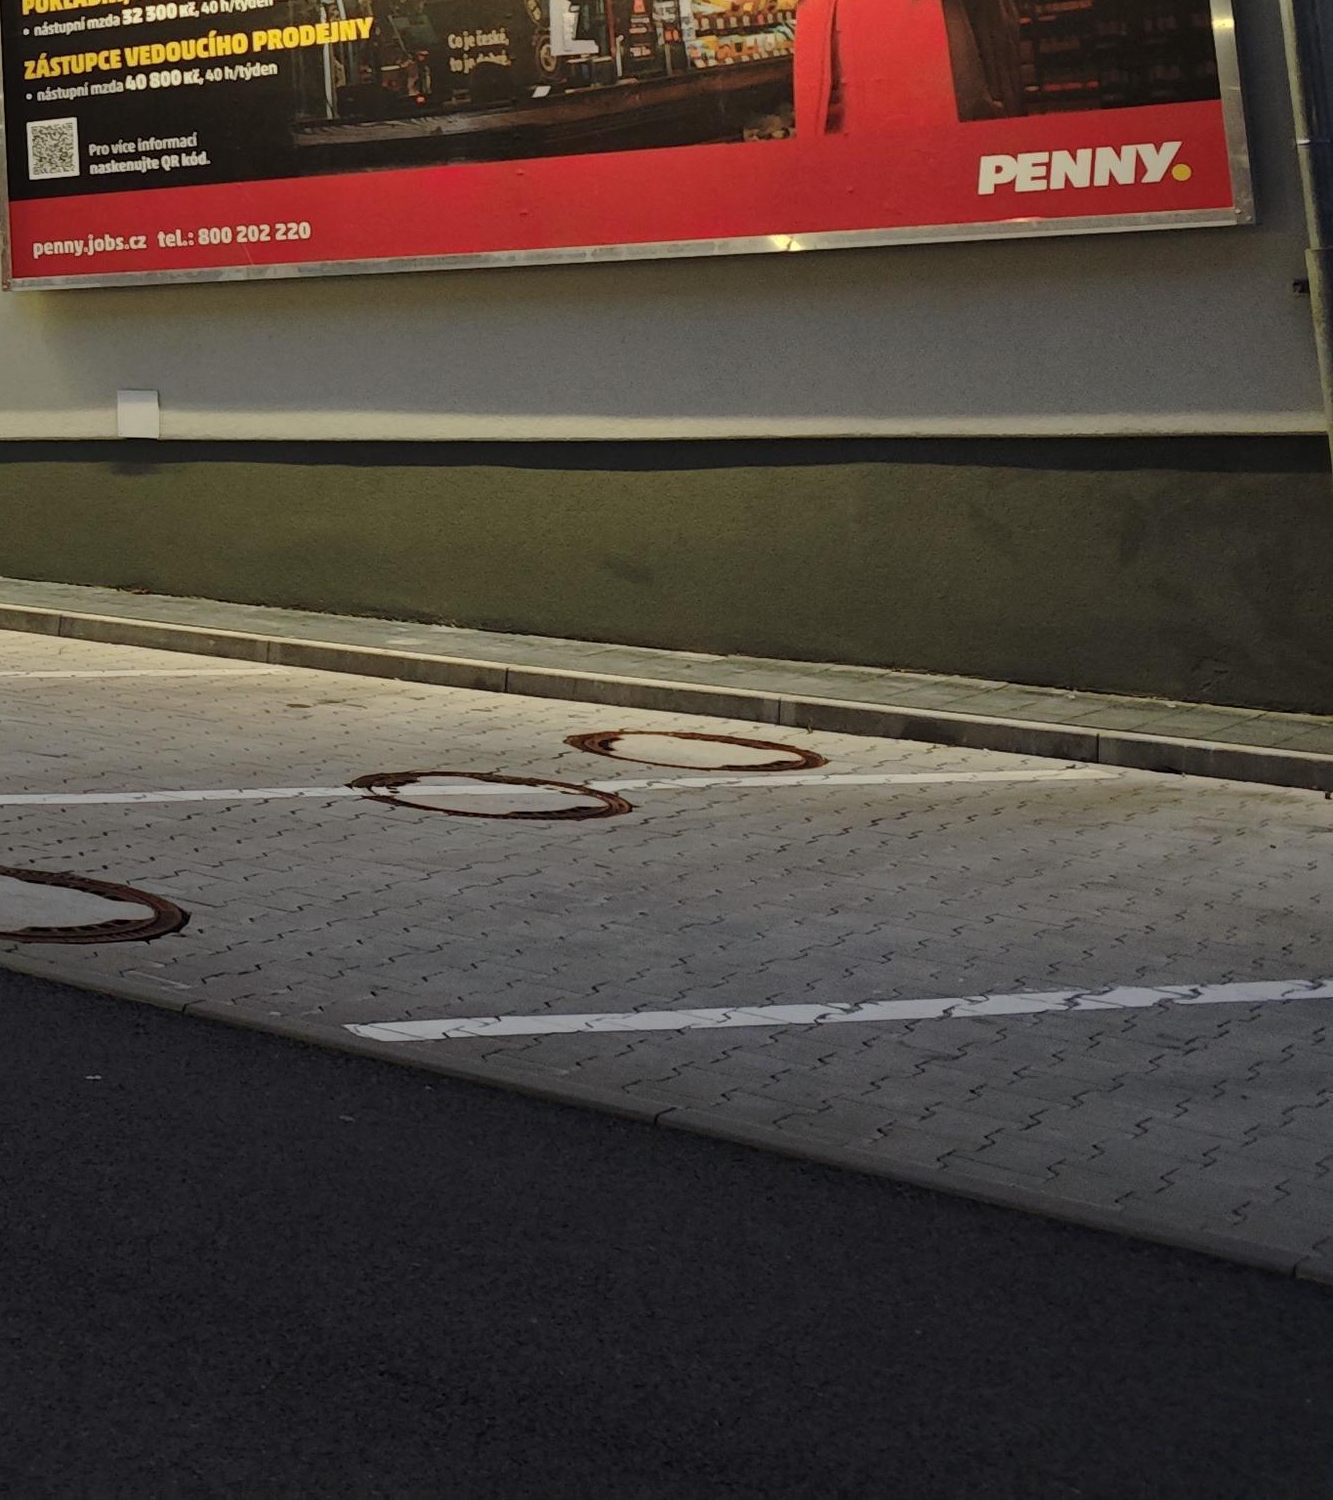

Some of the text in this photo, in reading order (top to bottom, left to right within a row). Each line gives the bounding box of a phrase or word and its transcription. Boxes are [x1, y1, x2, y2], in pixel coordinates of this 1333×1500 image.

[34, 16, 85, 37] nástupní
[87, 14, 121, 30] mzda
[122, 8, 143, 26] 32
[145, 3, 177, 22] 300
[201, 0, 219, 15] 40
[24, 16, 374, 80] ZÁSTUPCE VEDOUCÍHO PRODEJNY
[37, 84, 88, 102] nástupní
[91, 79, 124, 95] mzda
[125, 73, 147, 91] 40
[149, 69, 181, 87] 800
[205, 68, 222, 82] 40
[225, 62, 278, 81] h/týden
[88, 132, 198, 156] Pro více informací
[90, 151, 211, 175] naskenujte QR kód.
[33, 221, 311, 259] penny.jobs.cz tel.: 800 202 220
